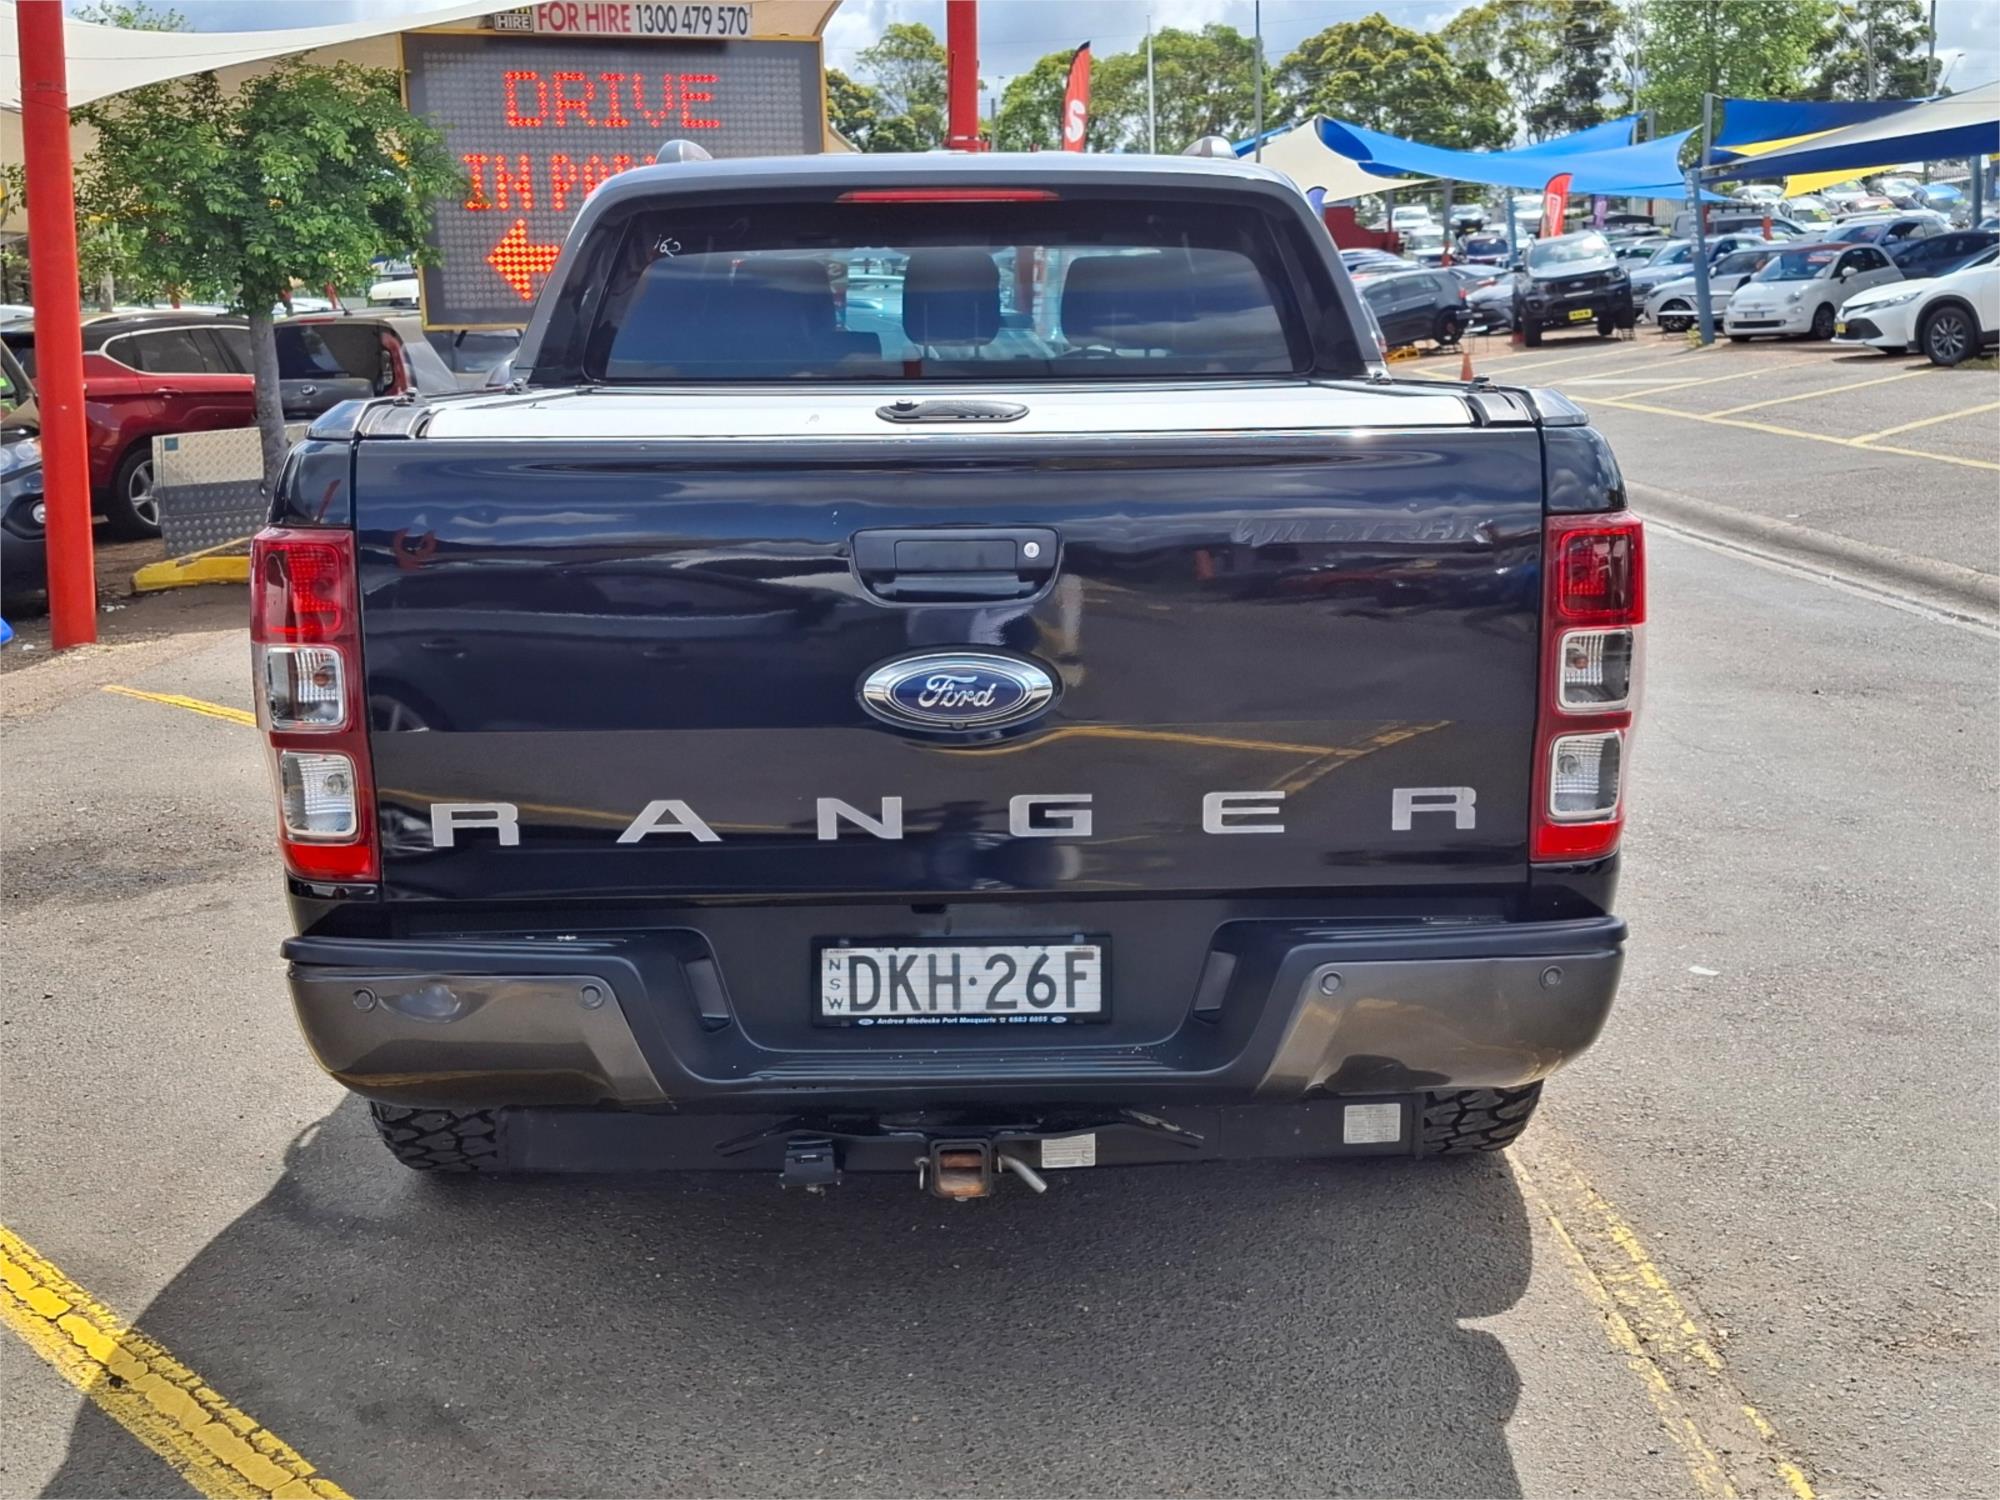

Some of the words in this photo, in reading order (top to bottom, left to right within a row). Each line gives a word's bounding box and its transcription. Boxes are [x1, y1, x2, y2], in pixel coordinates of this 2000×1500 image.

[497, 16, 530, 30] HIRE
[538, 2, 581, 32] FOR
[585, 4, 632, 33] HIRE
[635, 5, 678, 35] 1300
[681, 6, 712, 35] 479
[717, 6, 748, 36] 570
[503, 70, 721, 129] DRIVE
[463, 153, 534, 212] IN
[917, 674, 998, 708] Ford
[430, 785, 1477, 849] RANGER
